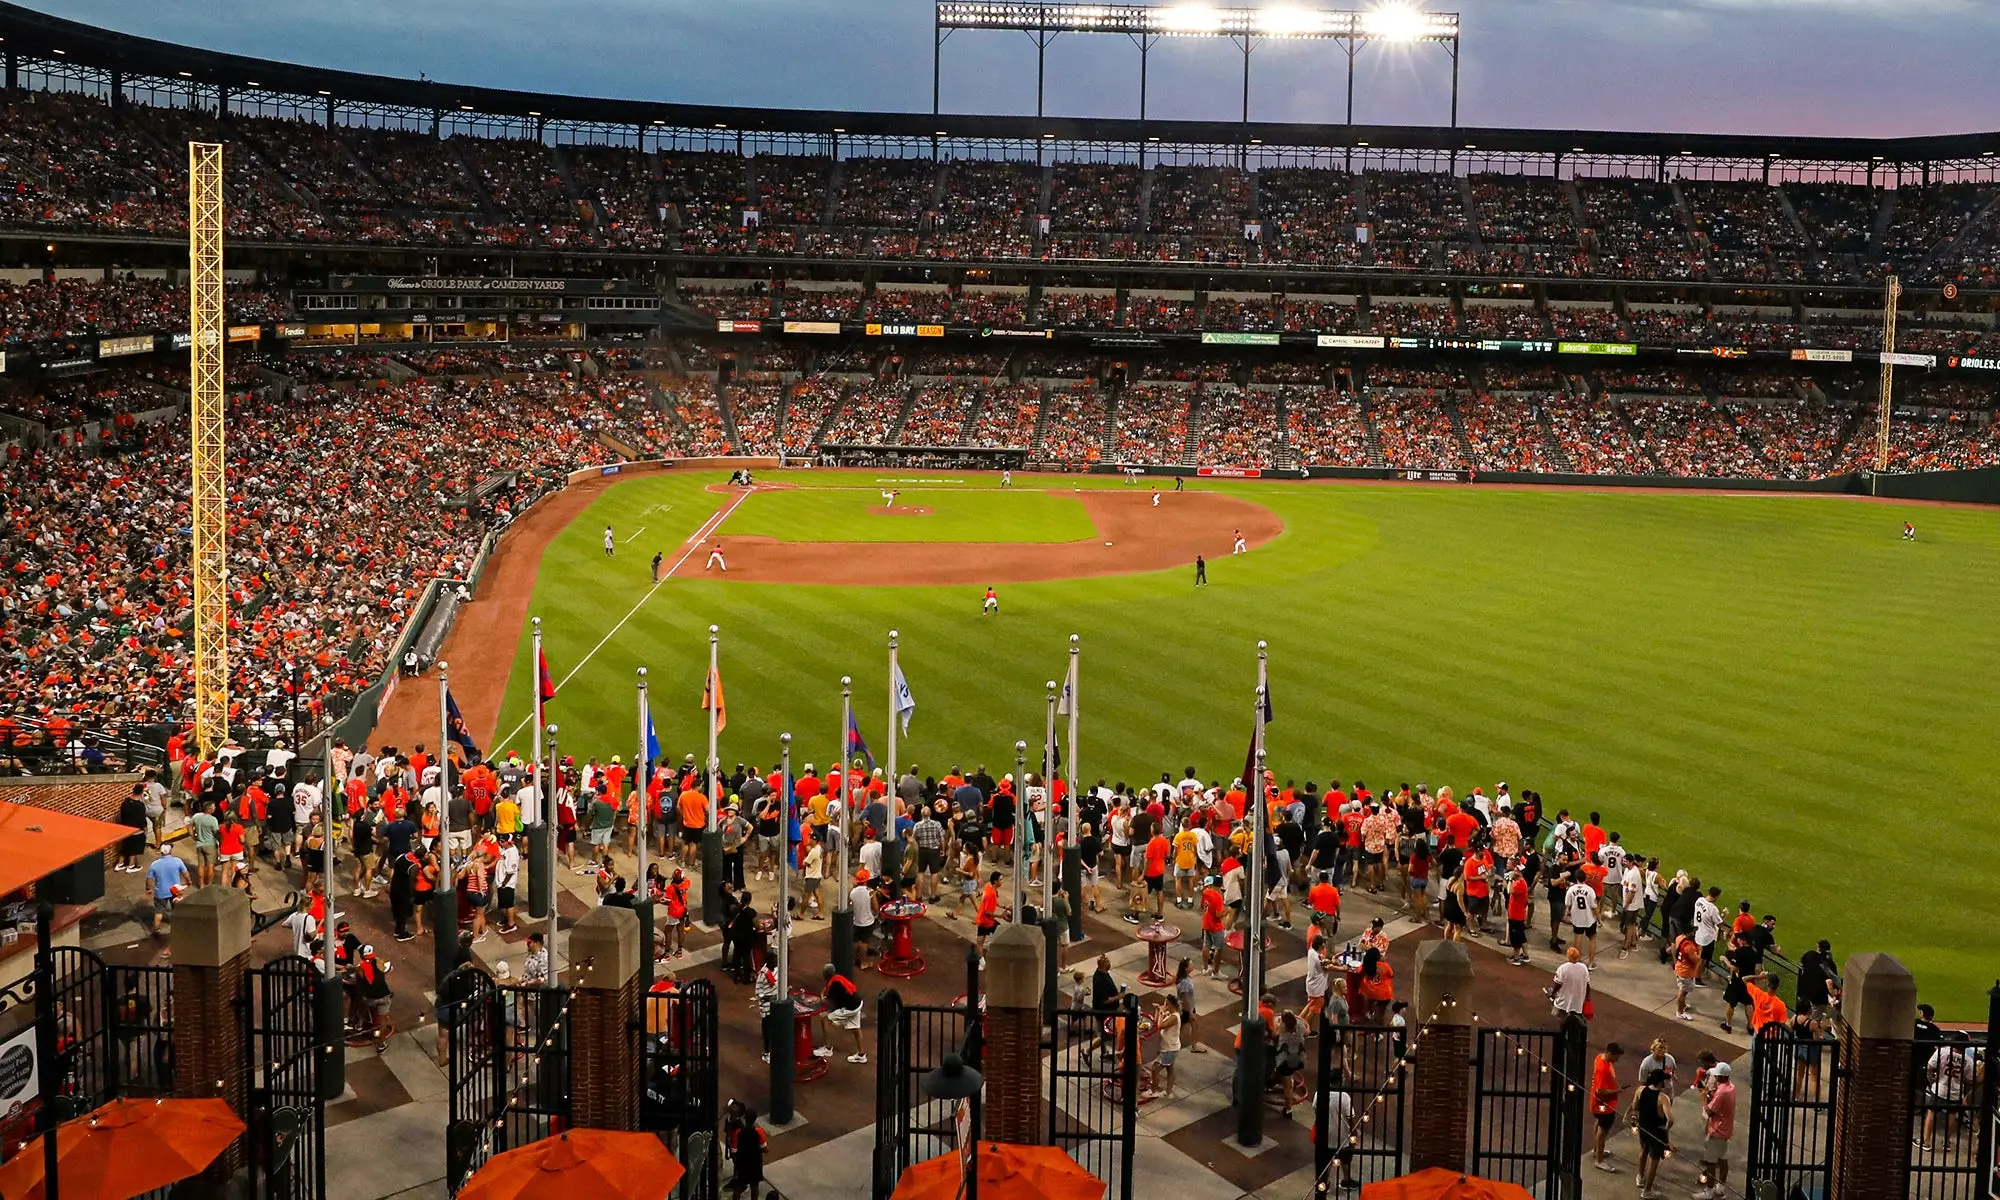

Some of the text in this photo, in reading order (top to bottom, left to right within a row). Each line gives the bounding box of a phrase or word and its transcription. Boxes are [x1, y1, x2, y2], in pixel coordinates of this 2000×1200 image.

[421, 280, 456, 289] ORIOLE
[457, 280, 482, 289] PARK
[491, 280, 533, 289] CAMDEN
[533, 281, 565, 290] YARDS
[883, 325, 899, 335] OLD
[919, 326, 943, 336] SEASON
[1407, 470, 1422, 480] Lite
[295, 794, 307, 807] 35
[1182, 841, 1193, 851] 50
[1608, 856, 1617, 868] 8
[1576, 896, 1587, 910] 8
[1696, 911, 1702, 923] 8
